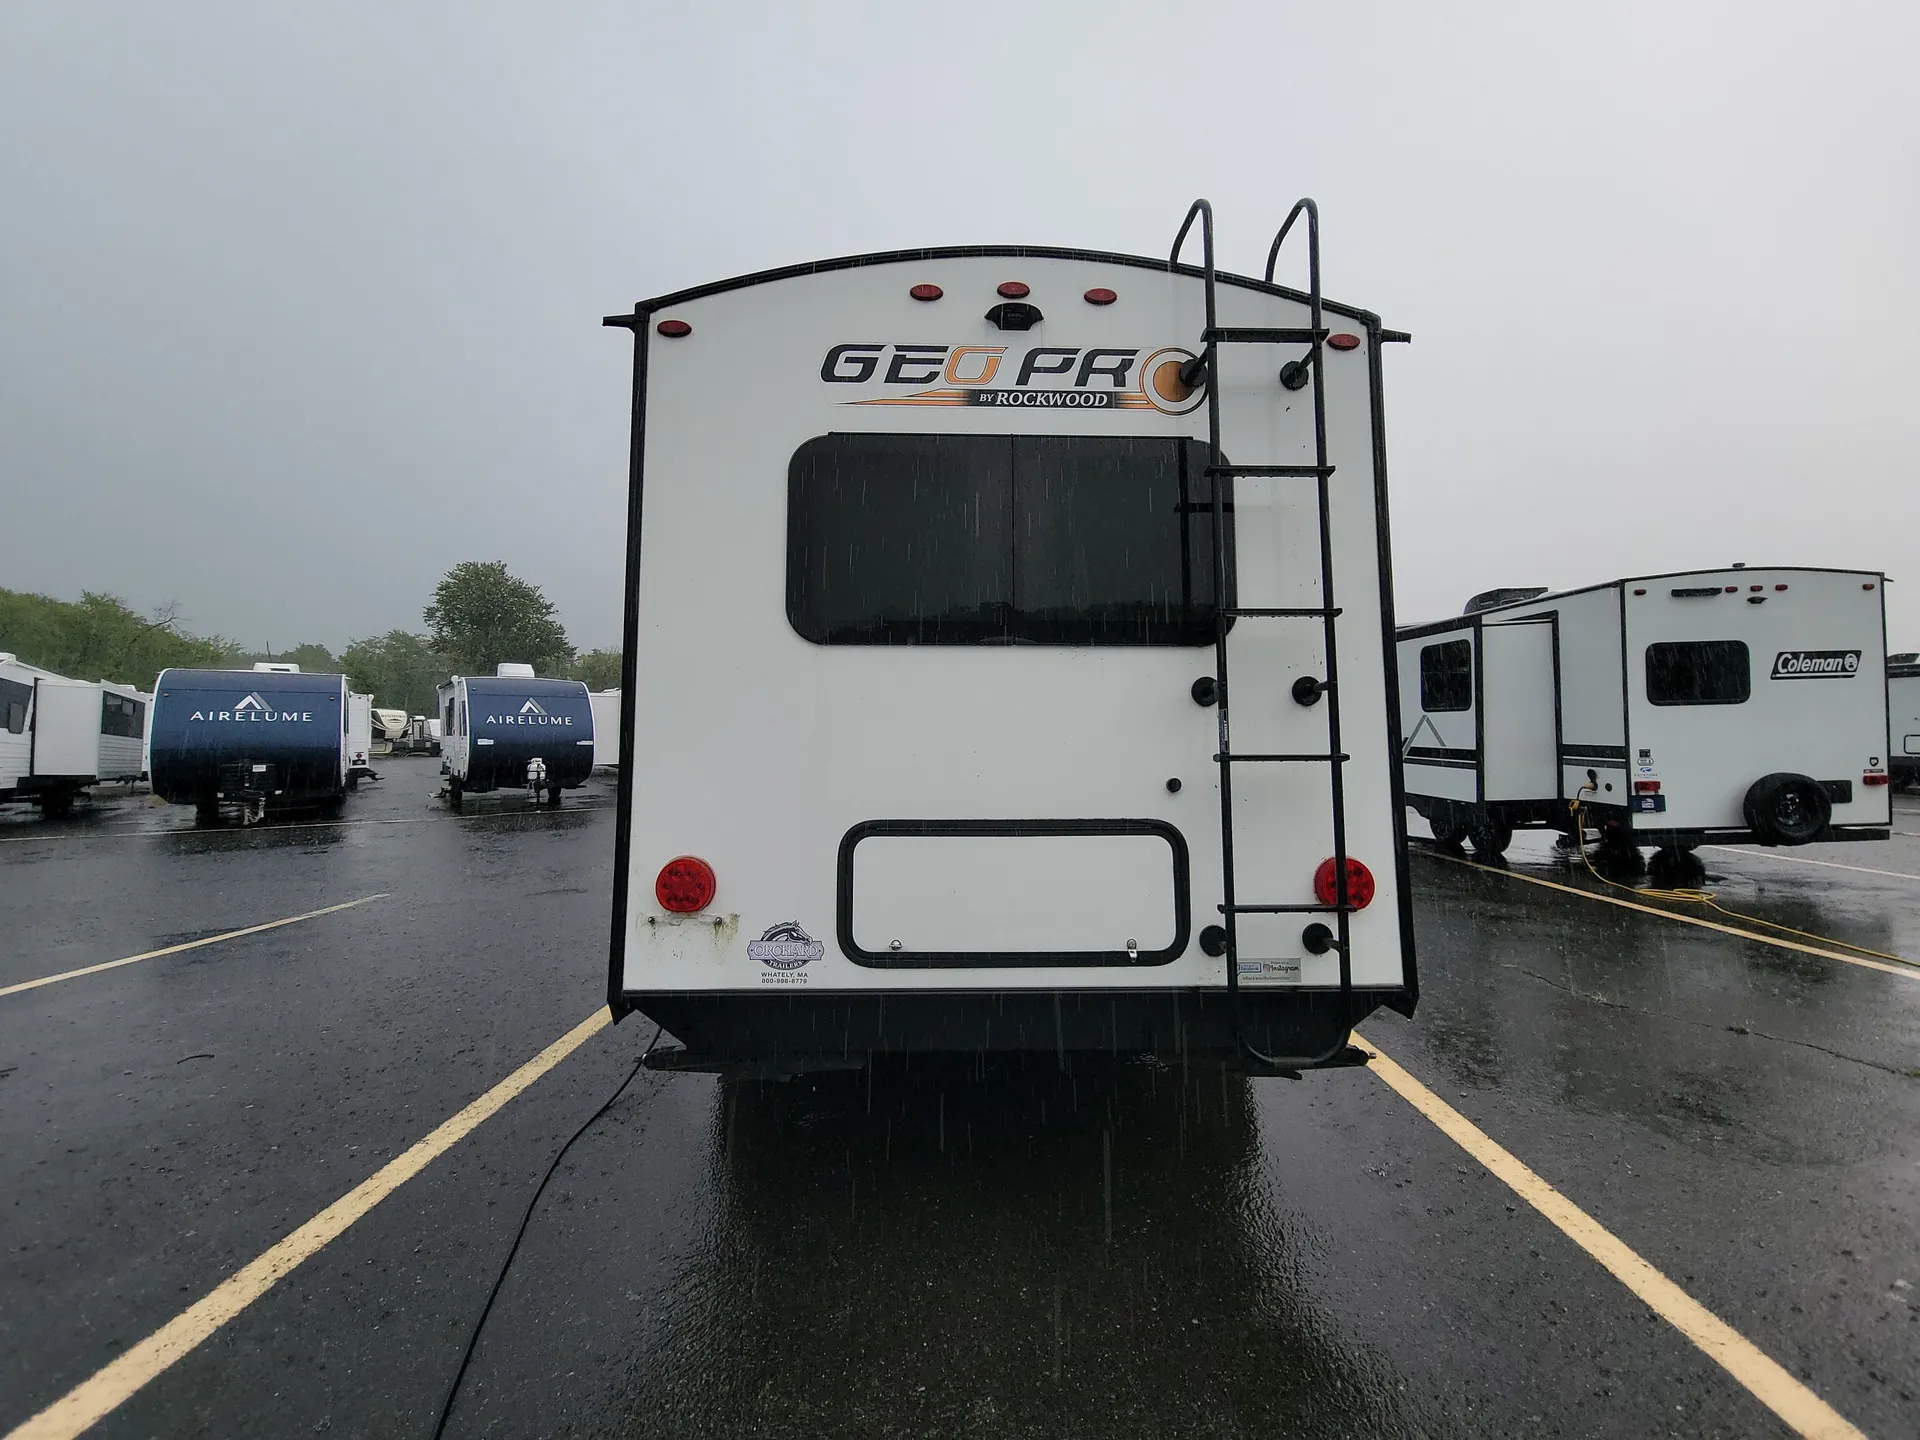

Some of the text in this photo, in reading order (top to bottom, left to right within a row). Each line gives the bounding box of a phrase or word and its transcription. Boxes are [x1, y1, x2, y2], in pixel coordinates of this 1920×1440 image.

[820, 344, 1009, 385] GEO
[979, 392, 1108, 407] BY ROCKWOOD
[1777, 653, 1843, 673] Coleman
[190, 711, 313, 721] AIRELUME
[486, 715, 573, 726] AIRELUME
[754, 944, 818, 958] ORCHARD
